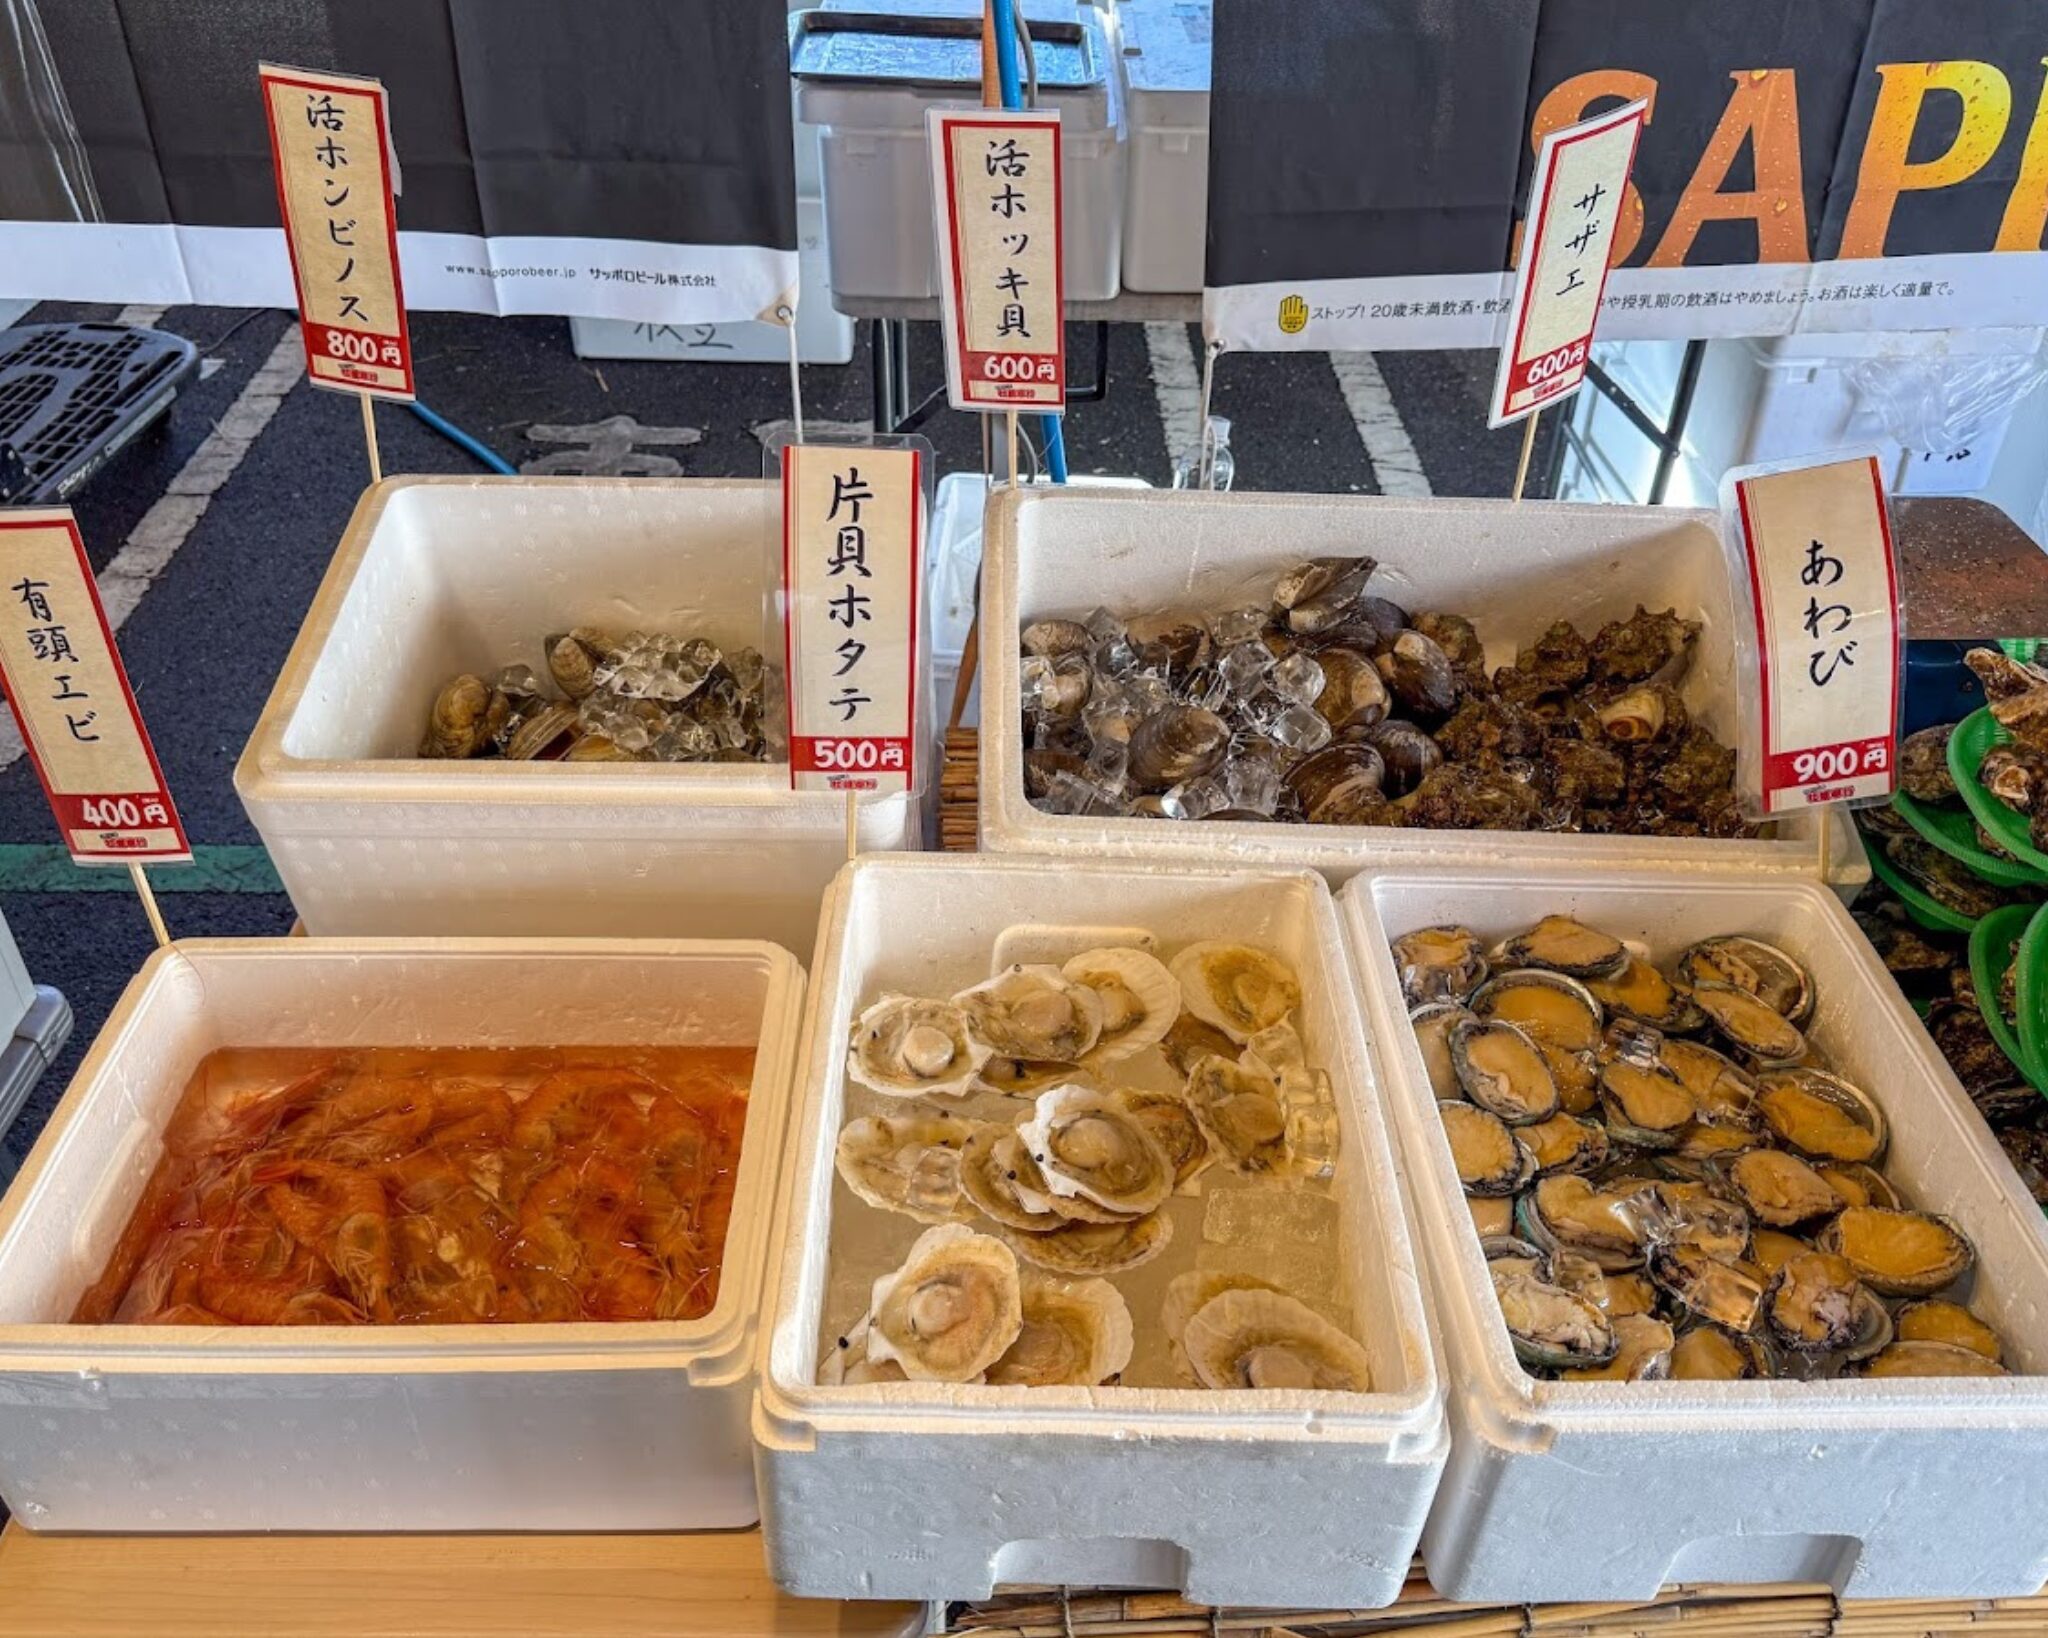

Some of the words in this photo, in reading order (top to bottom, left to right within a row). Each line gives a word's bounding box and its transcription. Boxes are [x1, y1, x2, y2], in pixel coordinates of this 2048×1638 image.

[1510, 58, 2048, 267] SAP
[306, 94, 369, 323] 活ホンビノス
[985, 138, 1031, 339] 活ホッキ貝
[1555, 182, 1607, 297] サザエ
[589, 266, 717, 287] サッポロビール株式会社
[326, 329, 401, 366] 800円
[983, 354, 1056, 382] 600円
[1526, 345, 1586, 385] 600円
[825, 466, 875, 723] 片貝ホタテ
[1800, 539, 1858, 687] あわび
[10, 577, 100, 742] 有頭エビ
[813, 738, 904, 770] 500円
[1792, 746, 1887, 783] 900円
[81, 797, 169, 828] 400円
